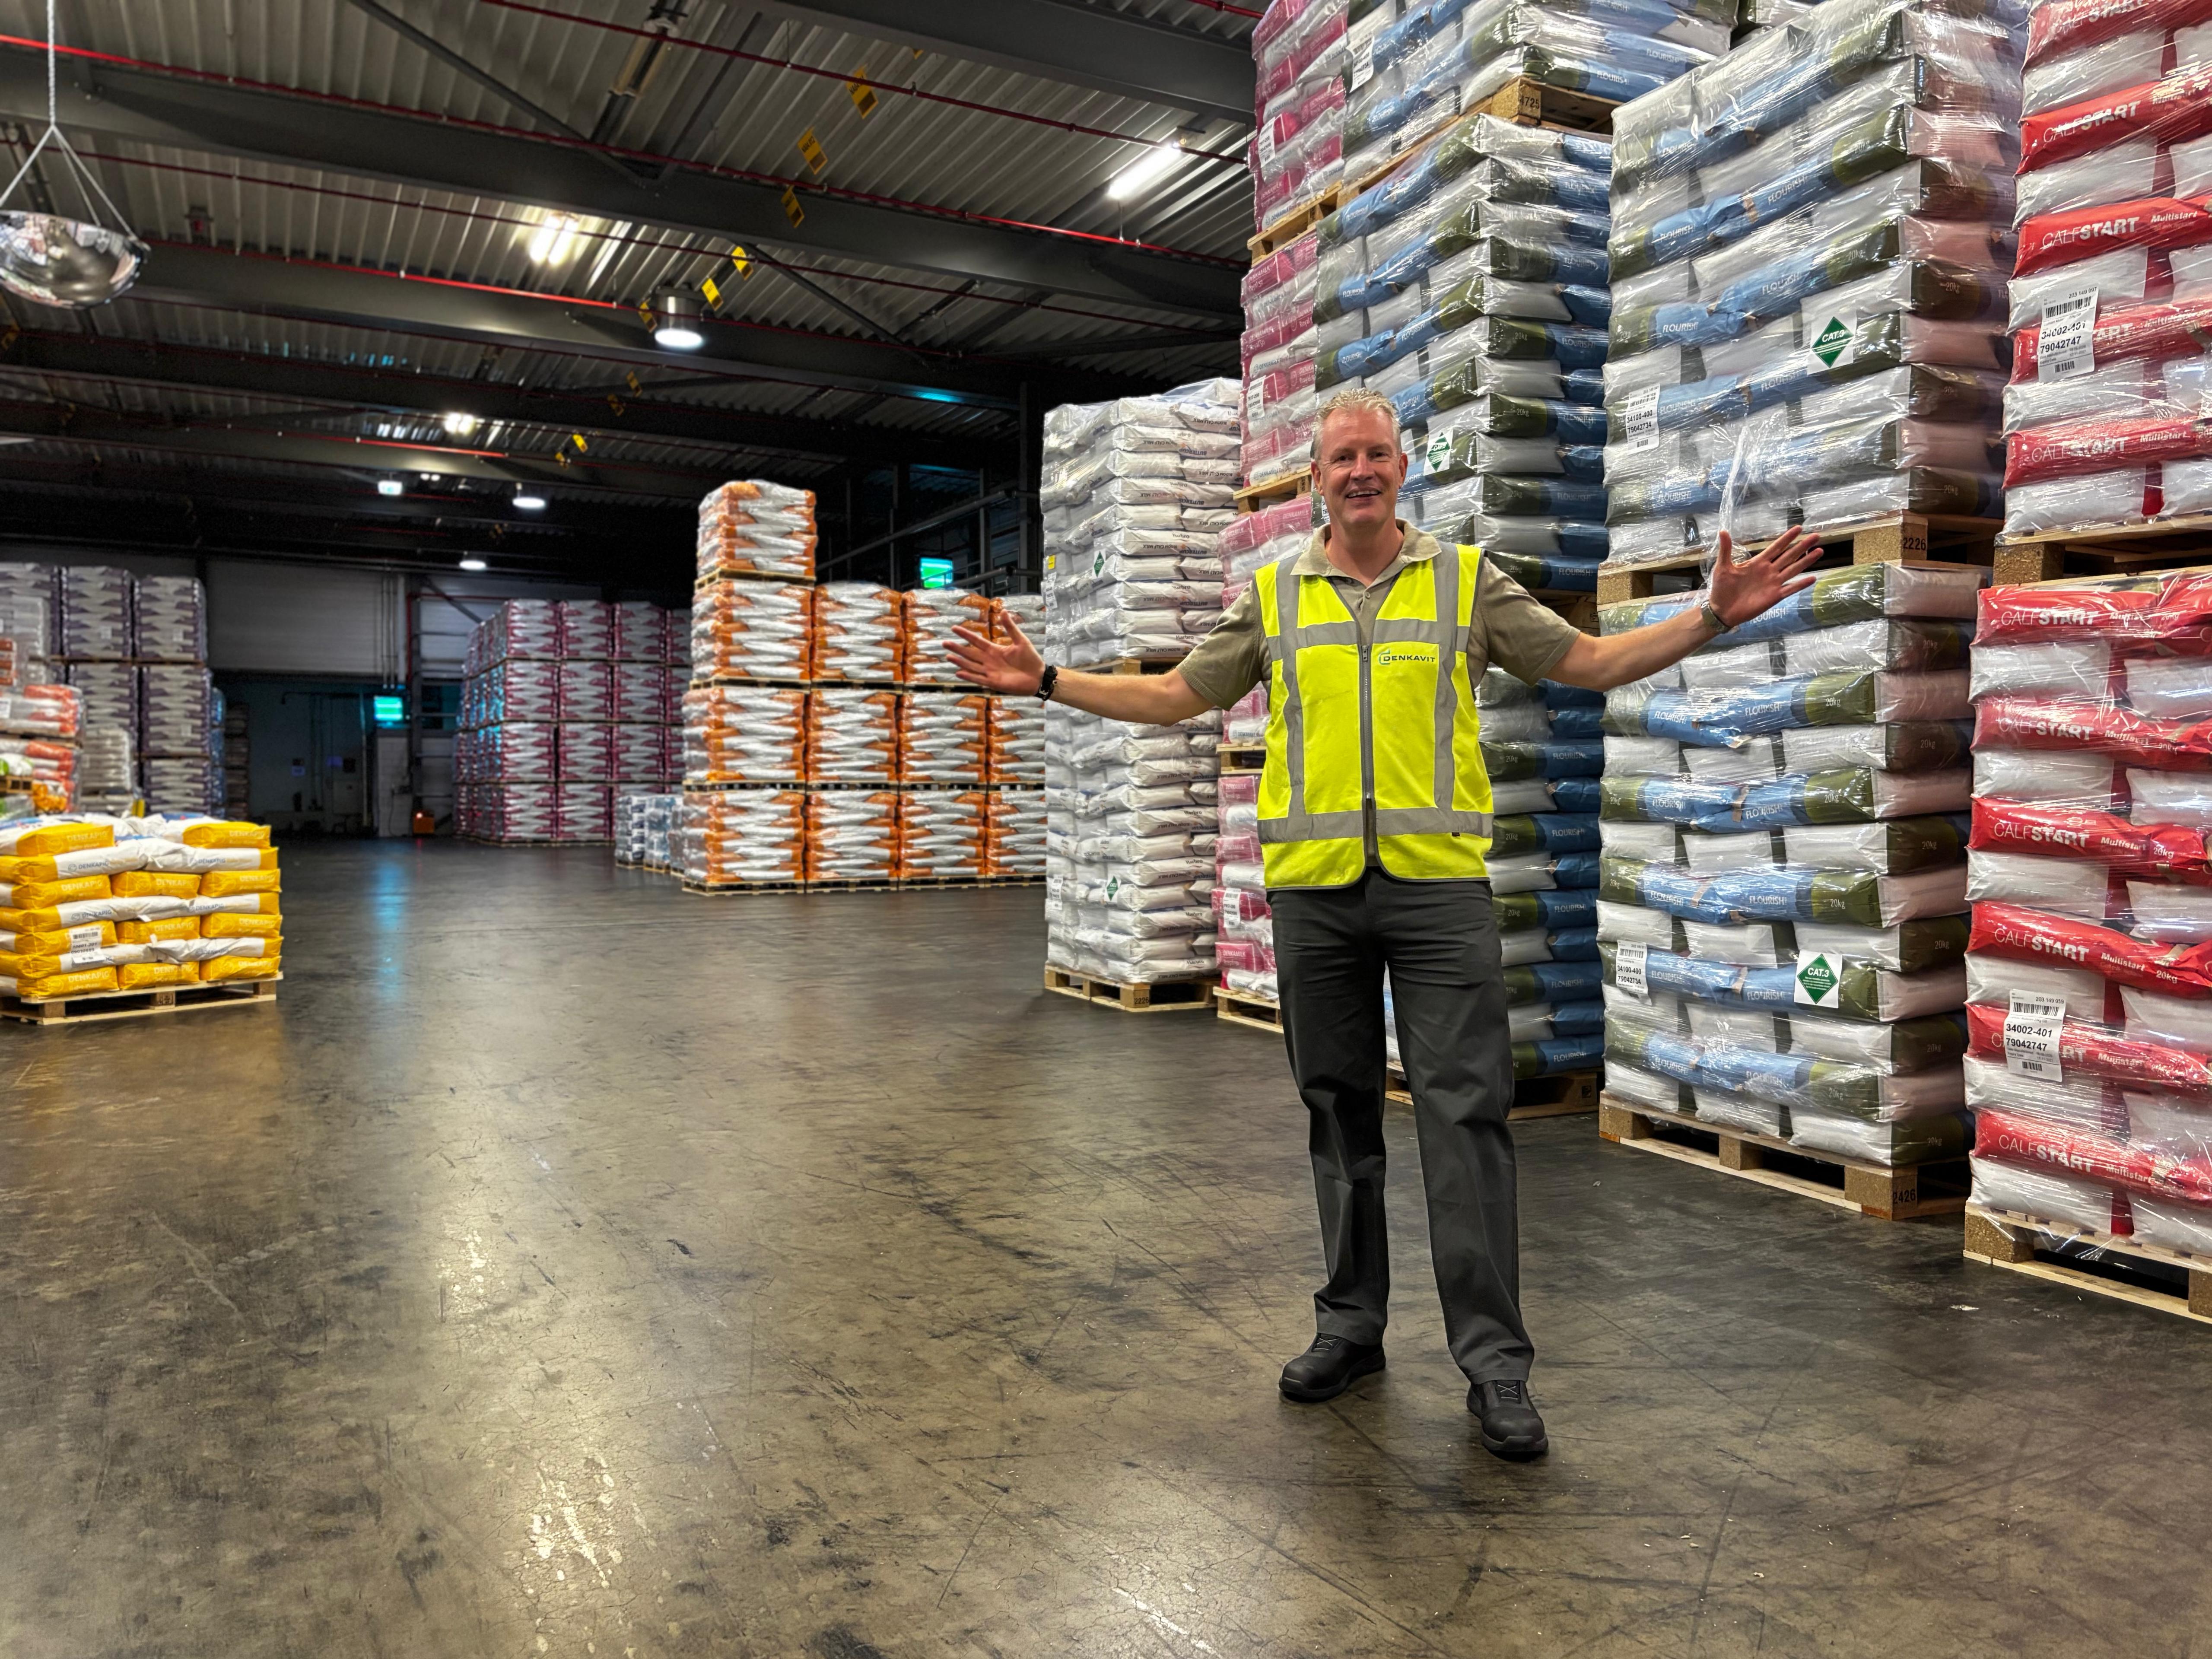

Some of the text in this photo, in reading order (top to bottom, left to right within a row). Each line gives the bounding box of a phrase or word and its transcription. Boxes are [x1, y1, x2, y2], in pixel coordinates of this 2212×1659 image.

[2042, 211, 2198, 246] CALFSTART Multistart
[1945, 283, 1960, 293] 20kg
[1515, 332, 1527, 341] 20kg
[2040, 336, 2082, 353] 79042747
[1517, 408, 1529, 416] 20kg
[1627, 410, 1653, 423] 34100-400
[1627, 421, 1652, 433] 79042734
[1903, 538, 1926, 550] 2226
[1559, 568, 1591, 576] FLOURISH
[2001, 610, 2099, 626] CALFSTART
[1826, 698, 1841, 707] 20kg
[1999, 718, 2094, 741] CALFSTART
[1920, 740, 1936, 749] 20kg
[1824, 795, 1839, 804] 20kg
[1922, 841, 1937, 850] 20kg
[1994, 823, 2174, 859] CALFSTART Multistart 20kg
[1749, 896, 1786, 905] FLOURISH
[1830, 899, 1845, 909] 20kg
[1508, 909, 1520, 917] 20kg
[1935, 941, 1949, 950] 20kg
[1994, 928, 2178, 983] CALFSTART Multistart 20kg
[1618, 966, 1641, 975] 34100-400
[1808, 967, 1829, 977] CAT.3
[1618, 976, 1641, 985] 79042734
[2006, 1023, 2052, 1037] 34002-401
[2006, 1038, 2047, 1051] 79042747
[1829, 1088, 1843, 1100] 20kg
[1999, 1135, 2094, 1173] CALFSTART
